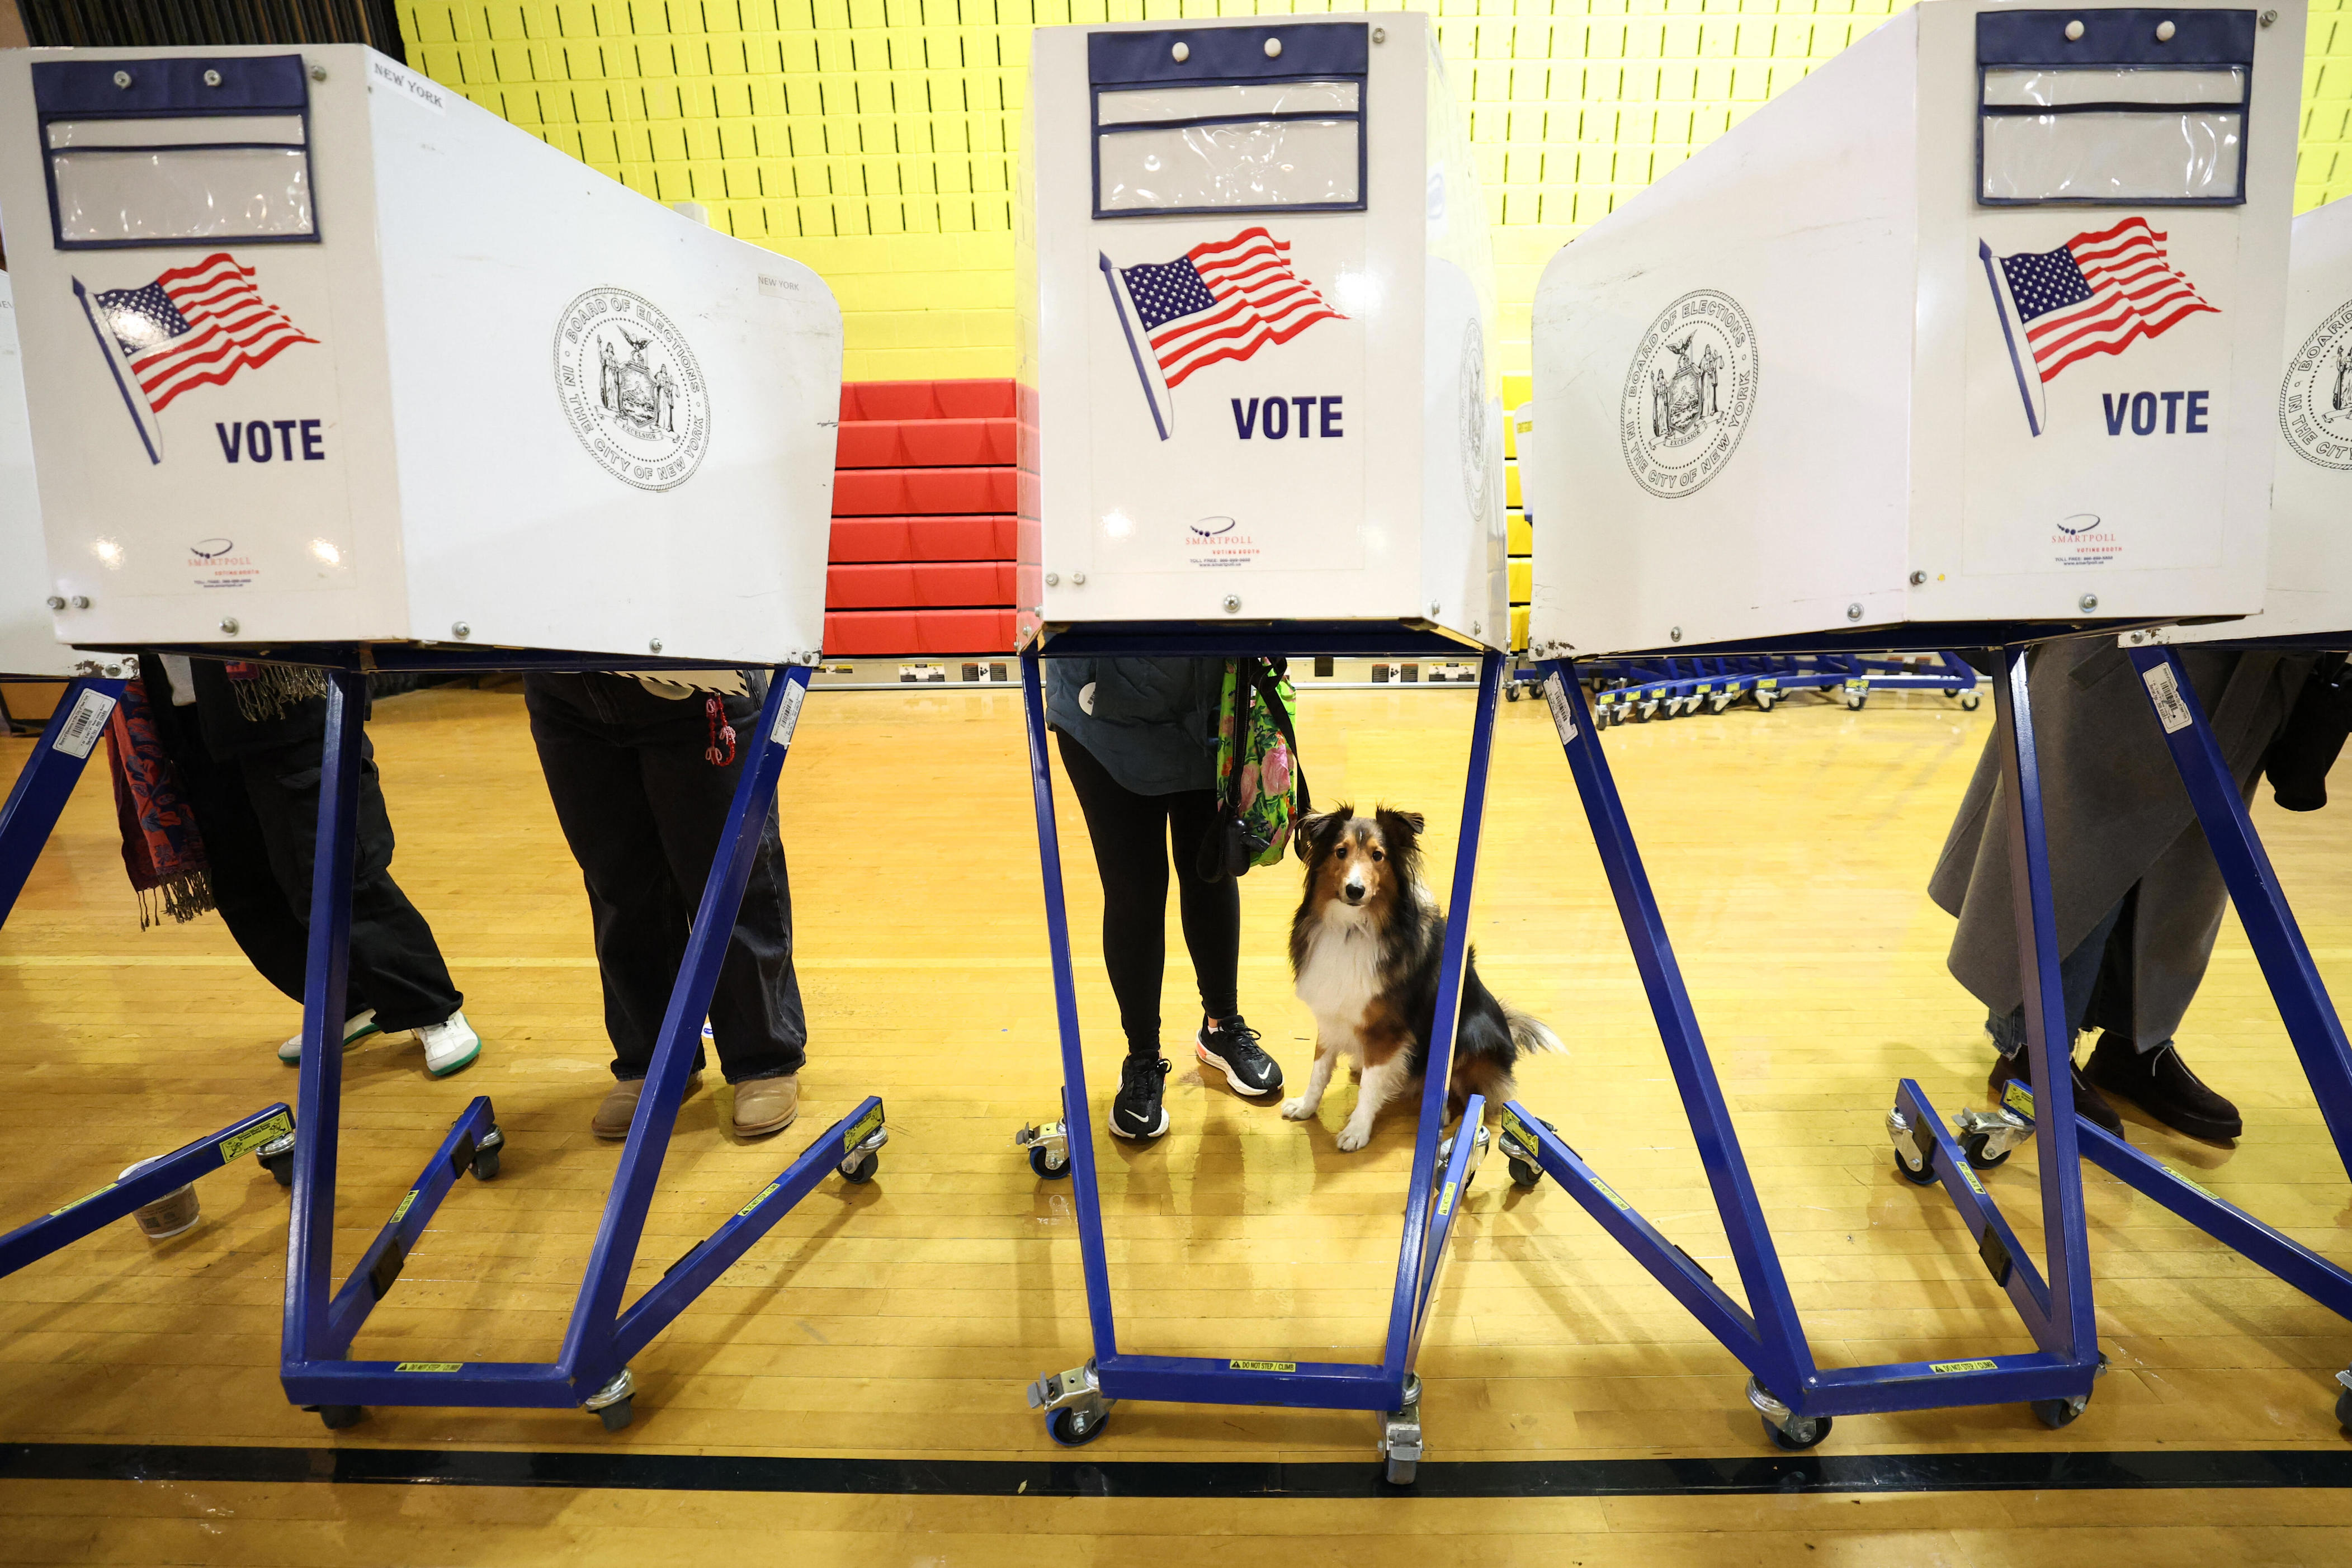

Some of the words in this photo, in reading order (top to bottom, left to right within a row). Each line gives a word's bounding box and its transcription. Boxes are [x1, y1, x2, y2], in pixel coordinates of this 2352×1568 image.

[375, 63, 404, 86] NEW
[408, 80, 443, 108] YORK
[758, 276, 777, 286] NEW
[778, 280, 800, 291] YORK
[565, 297, 607, 344] BOARD
[611, 297, 630, 312] OF
[636, 305, 700, 393] ELECTIONS
[1628, 333, 1659, 397] BOARD
[1660, 311, 1677, 333] OF
[1682, 300, 1746, 348] ELECTIONS
[1728, 370, 1751, 428] YORK
[2102, 390, 2210, 436] VOTE
[2289, 394, 2302, 413] IN
[562, 365, 576, 387] IN
[569, 394, 594, 434] THE
[594, 438, 630, 472] CITY
[634, 466, 653, 480] OF
[658, 456, 686, 480] NEW
[684, 415, 704, 459] YORK
[622, 423, 657, 440] EXCELSIOR
[1231, 395, 1344, 440] VOTE
[1626, 421, 1636, 441] IN
[2292, 414, 2318, 445] THE
[215, 419, 326, 464] VOTE
[1670, 429, 1701, 446] EXCELSIOR
[1630, 445, 1649, 474] THE
[1701, 433, 1730, 475] NEW
[1648, 469, 1677, 488] CITY
[1680, 469, 1697, 486] OF
[1186, 536, 1253, 545] SMARTPOLL
[2052, 533, 2116, 544] SMARTPOLL
